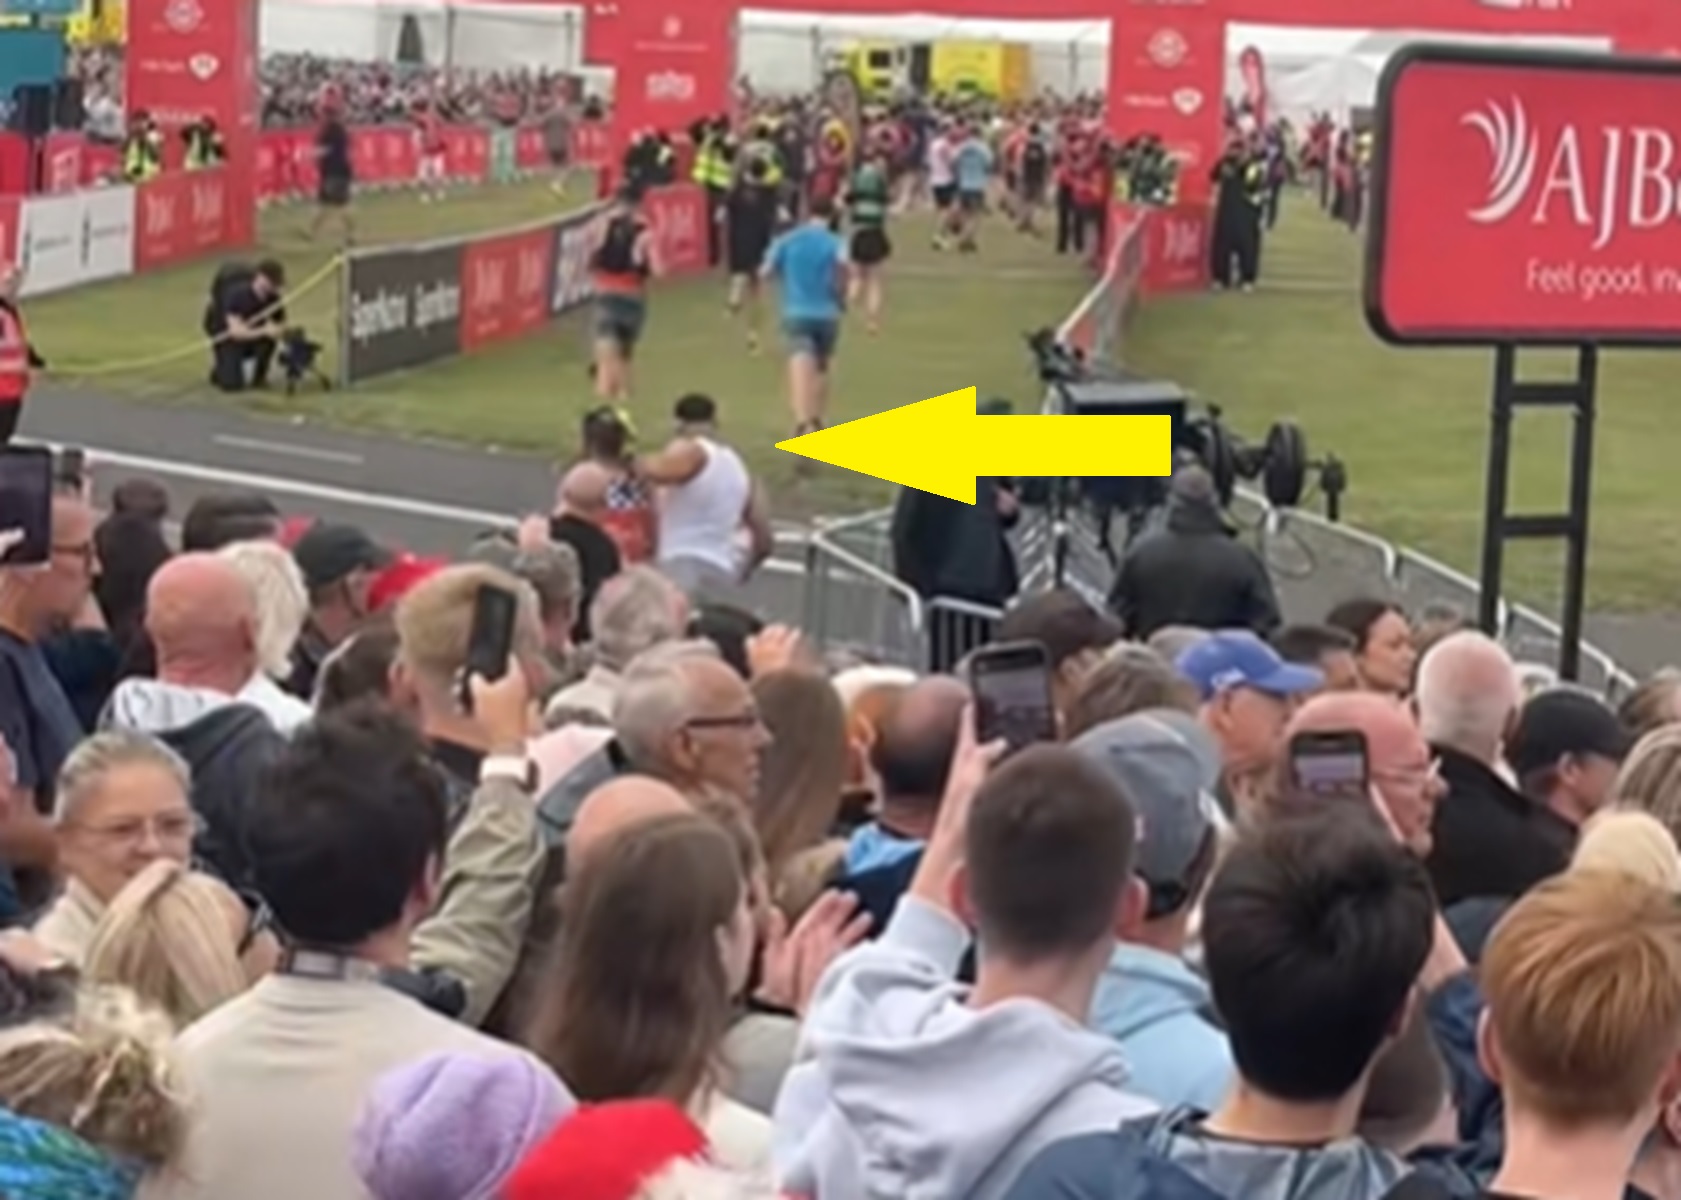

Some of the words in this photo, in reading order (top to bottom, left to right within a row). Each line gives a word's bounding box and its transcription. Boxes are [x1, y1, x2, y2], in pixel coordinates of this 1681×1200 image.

[1531, 124, 1681, 250] AJB
[1526, 257, 1575, 293] Feel
[1578, 260, 1648, 301] good,
